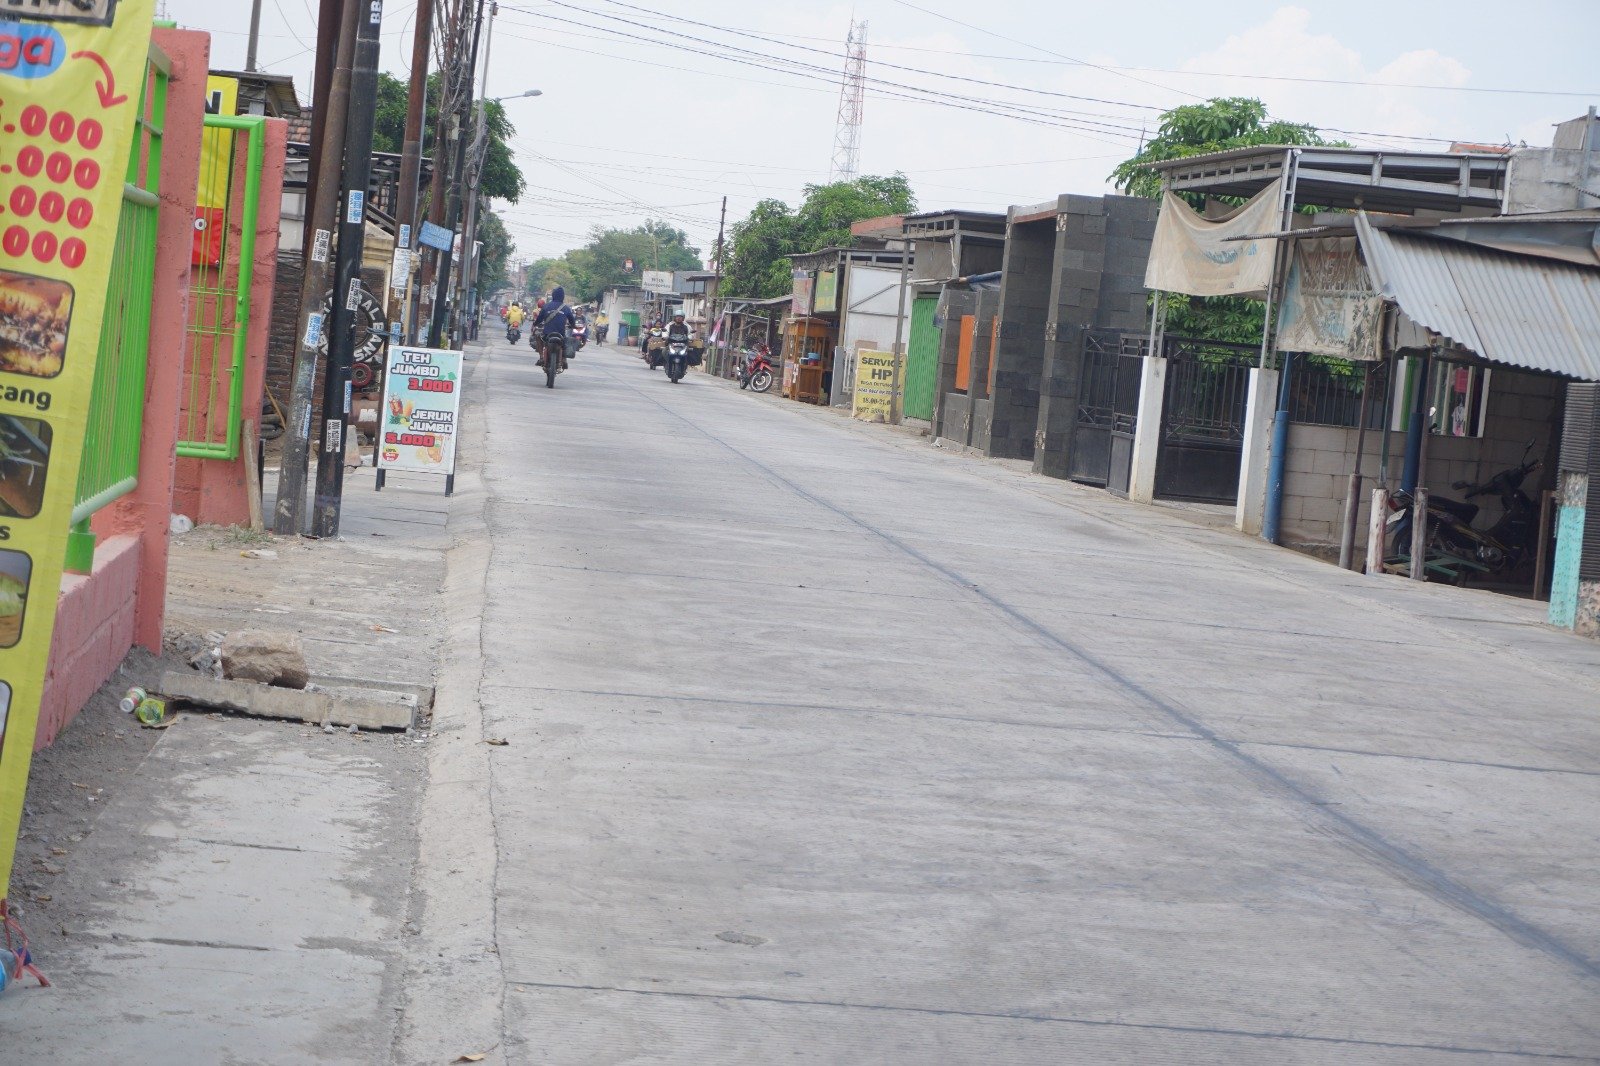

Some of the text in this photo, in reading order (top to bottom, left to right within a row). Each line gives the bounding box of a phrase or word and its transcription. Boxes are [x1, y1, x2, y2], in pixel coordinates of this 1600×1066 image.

[0, 104, 104, 151] .000
[402, 351, 431, 365] TEH
[391, 363, 440, 378] JUMBO
[871, 368, 893, 381] HP
[408, 377, 454, 394] 3.000
[411, 409, 454, 422] JERUK
[408, 420, 454, 434] JUMBO
[385, 432, 436, 448] 5.000
